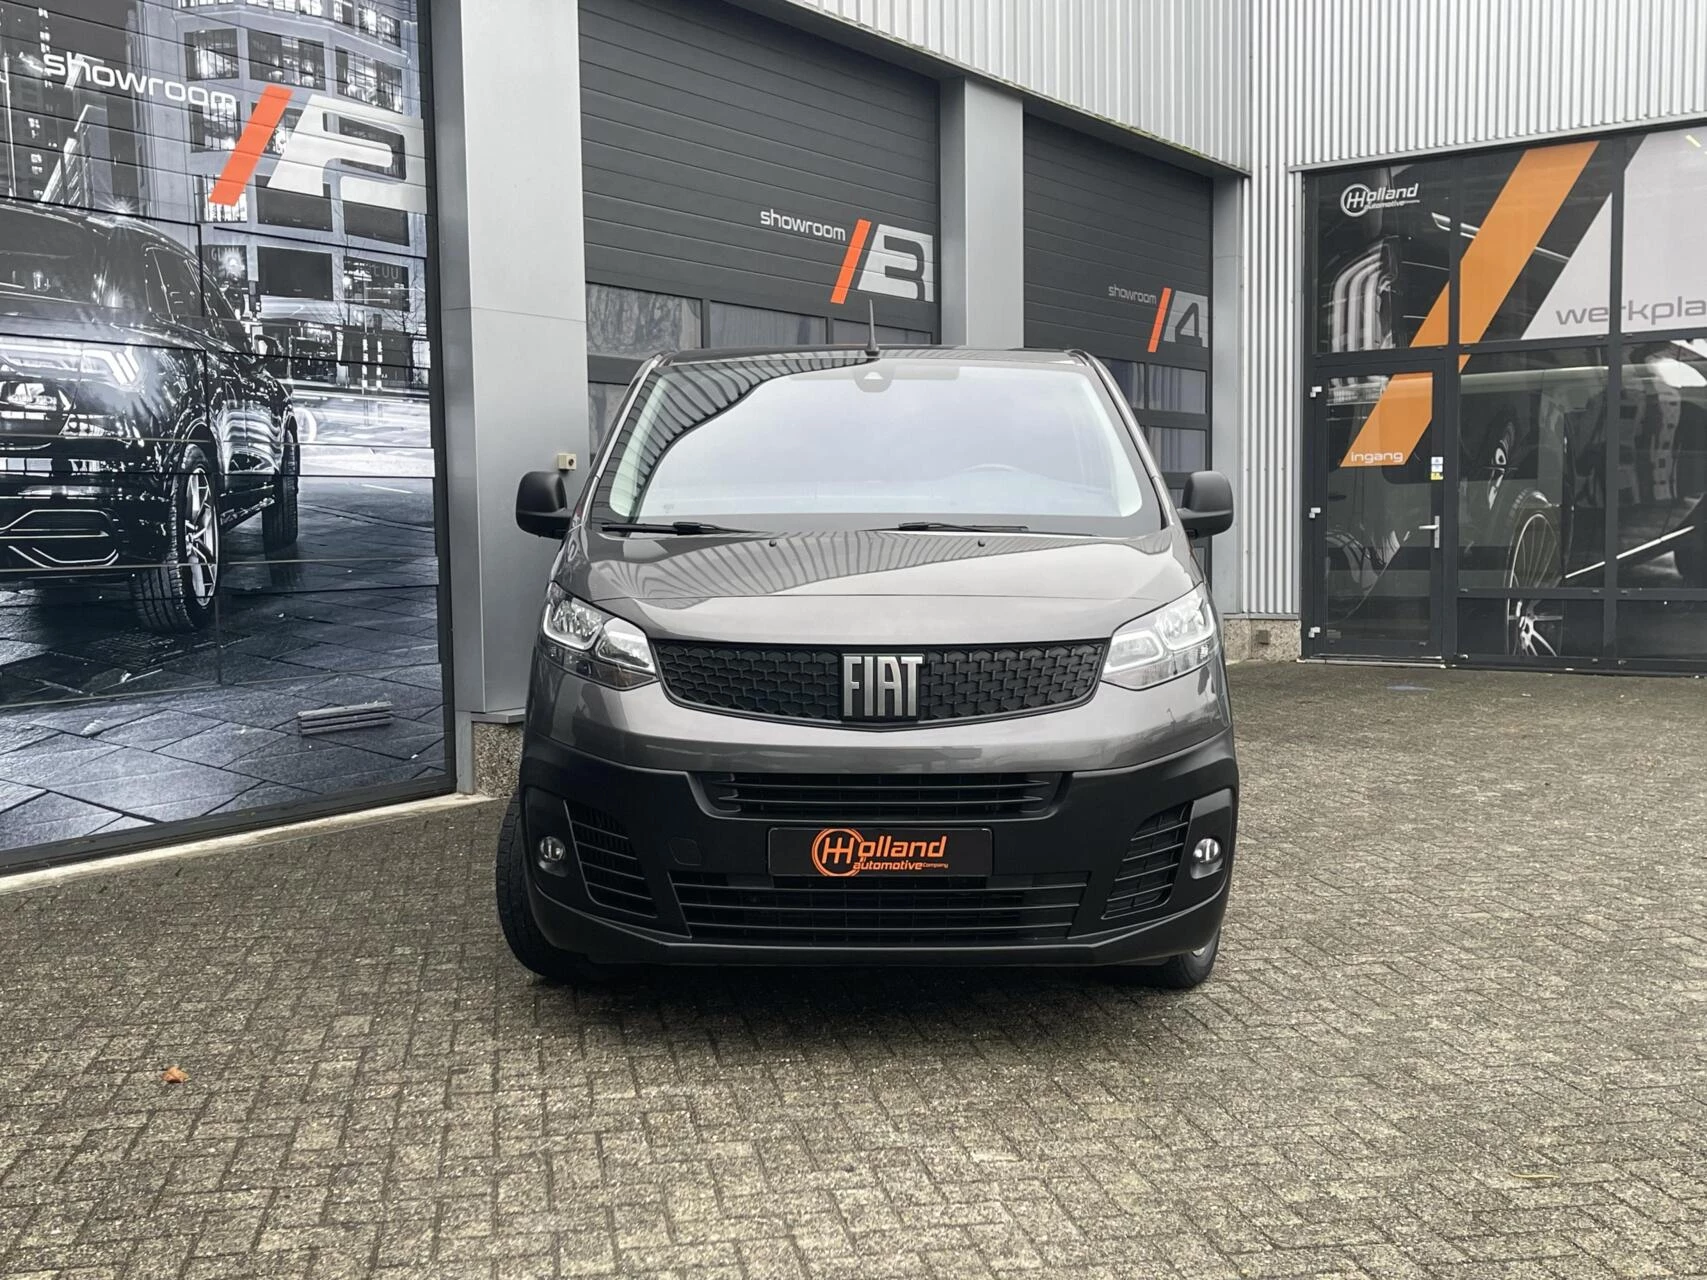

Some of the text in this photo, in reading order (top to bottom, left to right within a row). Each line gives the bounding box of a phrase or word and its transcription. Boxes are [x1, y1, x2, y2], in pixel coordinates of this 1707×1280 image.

[43, 51, 236, 105] showroom
[1345, 183, 1419, 211] Holland
[760, 209, 846, 241] showroom
[1108, 284, 1157, 304] showroom
[1556, 296, 1707, 325] wekpla
[1351, 452, 1404, 464] ingang
[843, 655, 923, 717] FIAT
[819, 835, 948, 864] Holland
[853, 859, 923, 871] automotive
